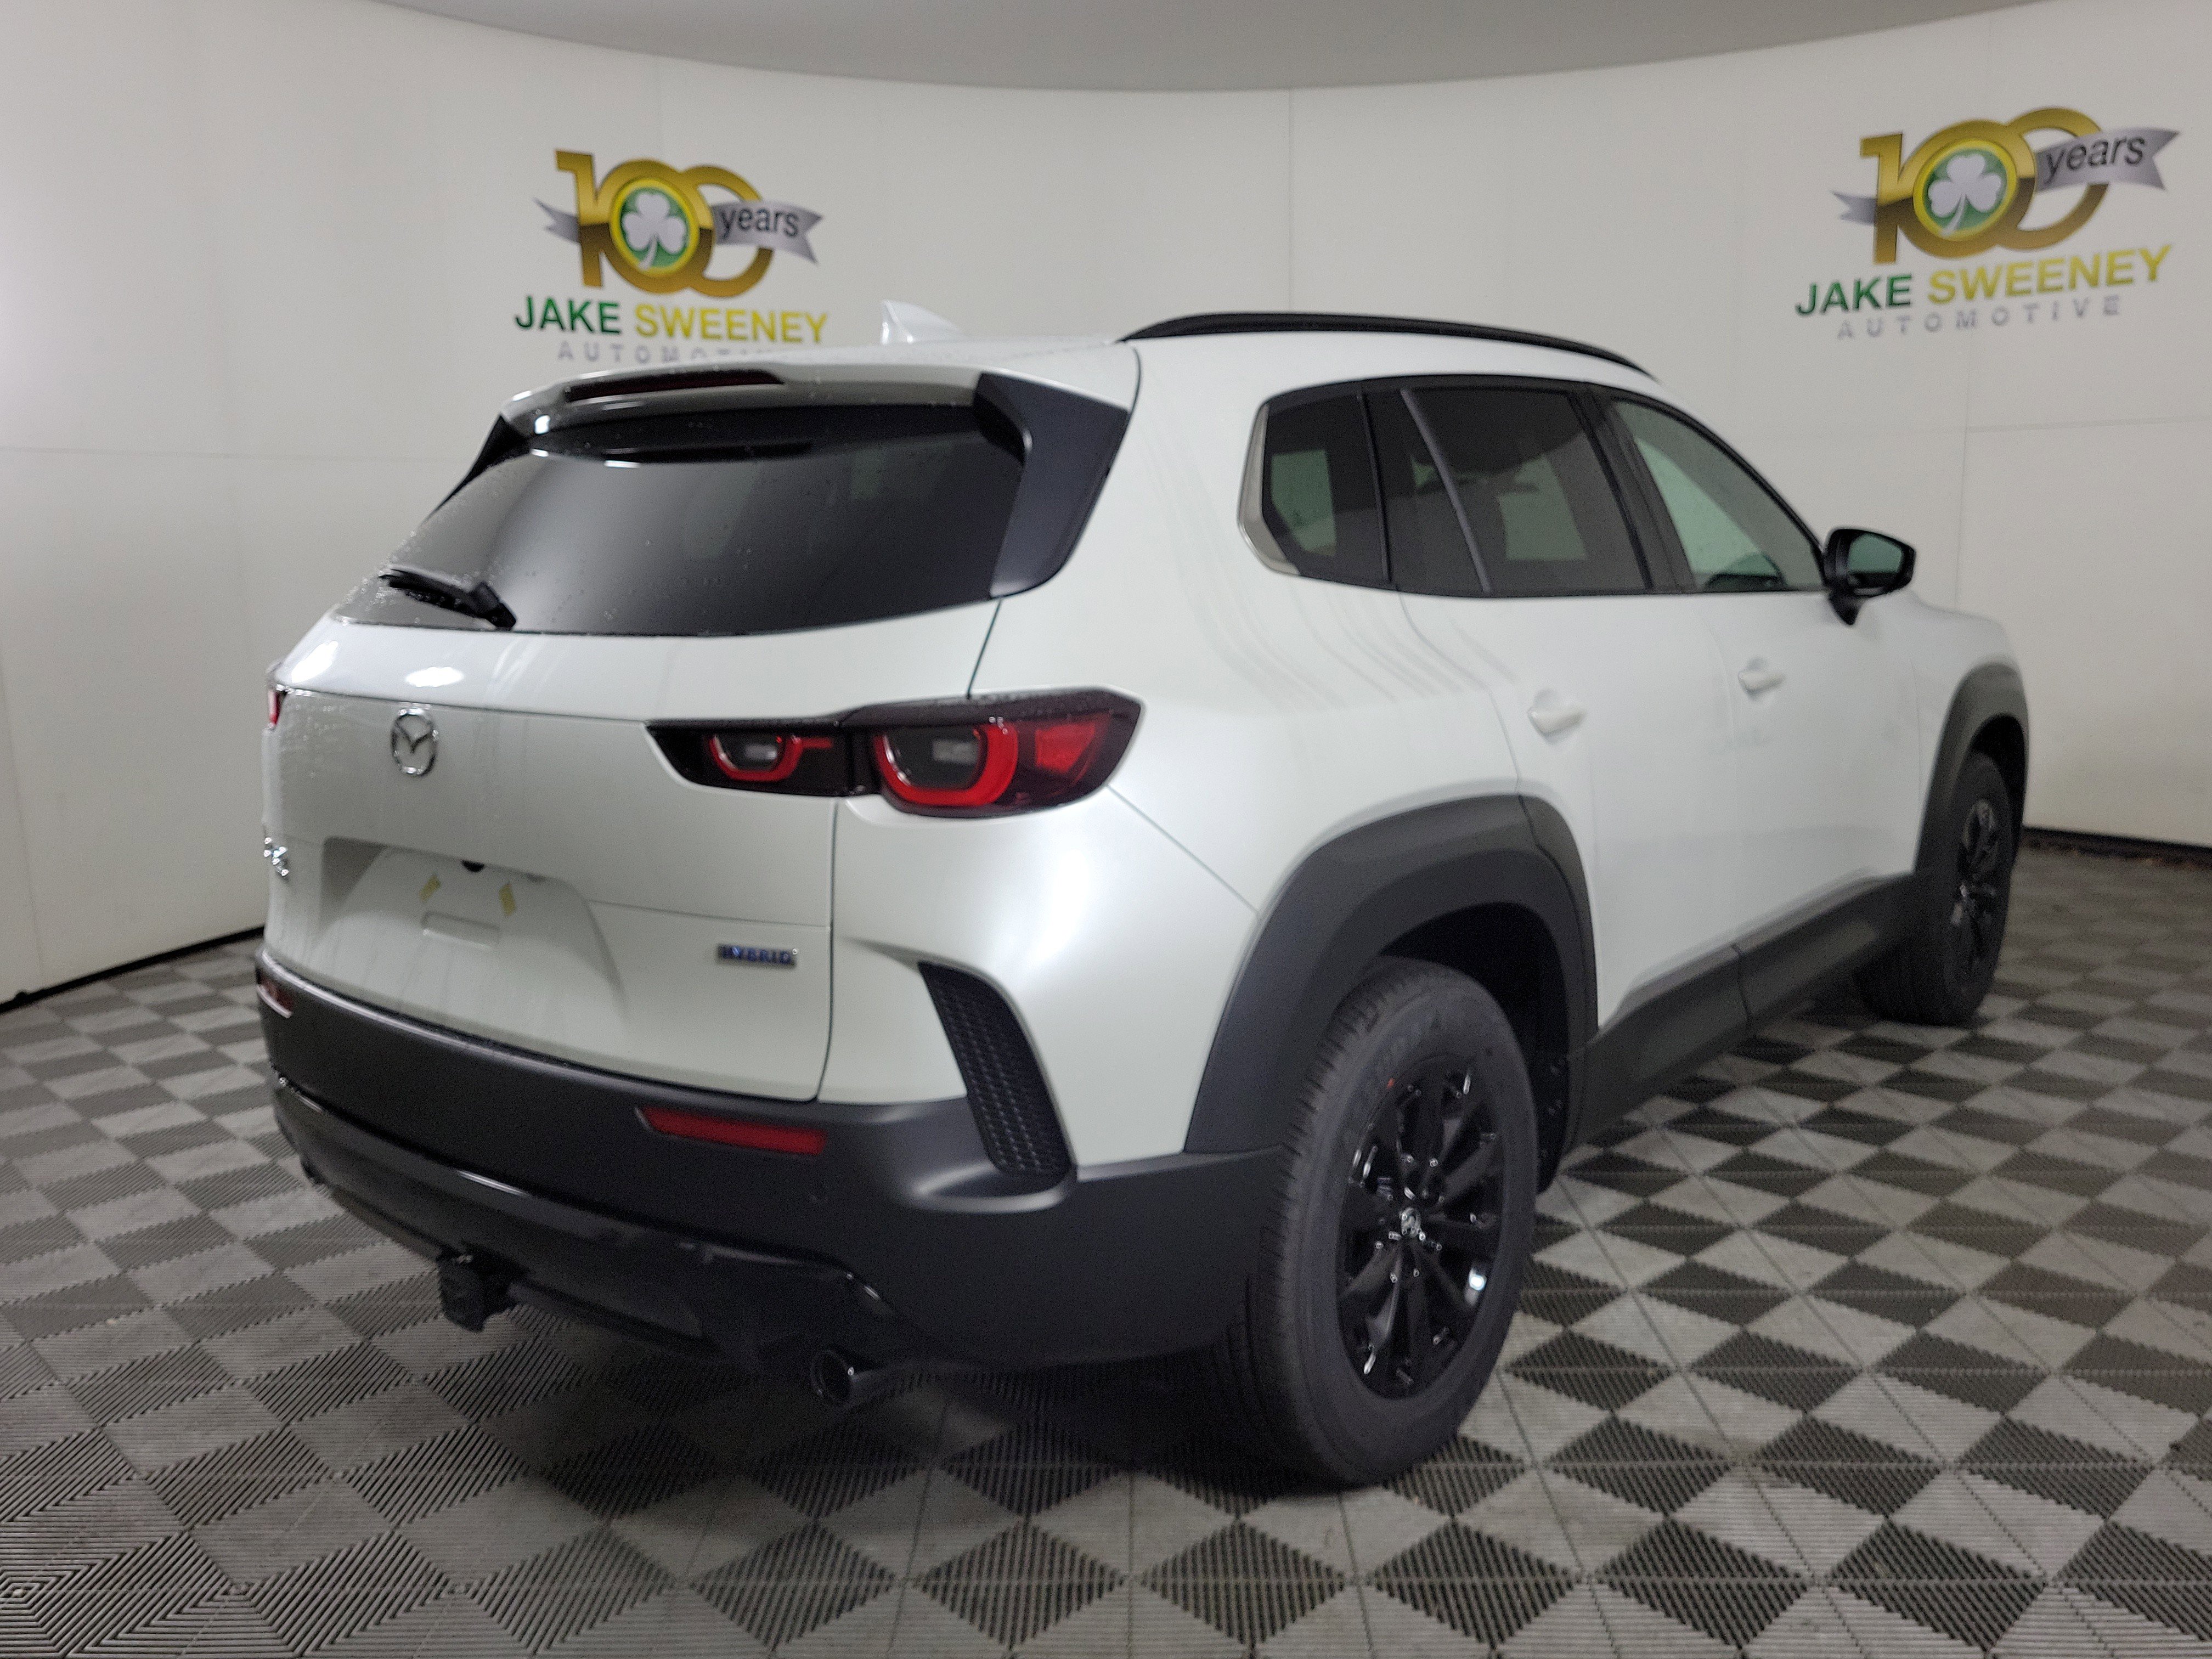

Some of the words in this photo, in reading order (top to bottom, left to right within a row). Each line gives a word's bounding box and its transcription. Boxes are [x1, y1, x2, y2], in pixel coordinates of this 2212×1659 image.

[1860, 107, 2109, 266] 100
[2045, 133, 2146, 184] years
[556, 150, 774, 297] 100
[721, 206, 799, 239] years
[1795, 274, 1912, 316] JAKE
[1927, 245, 2172, 304] SWEENEY
[516, 296, 621, 334] JAKE
[635, 304, 828, 343] SWEENEY
[1837, 295, 2120, 339] AUTOMOTIVE
